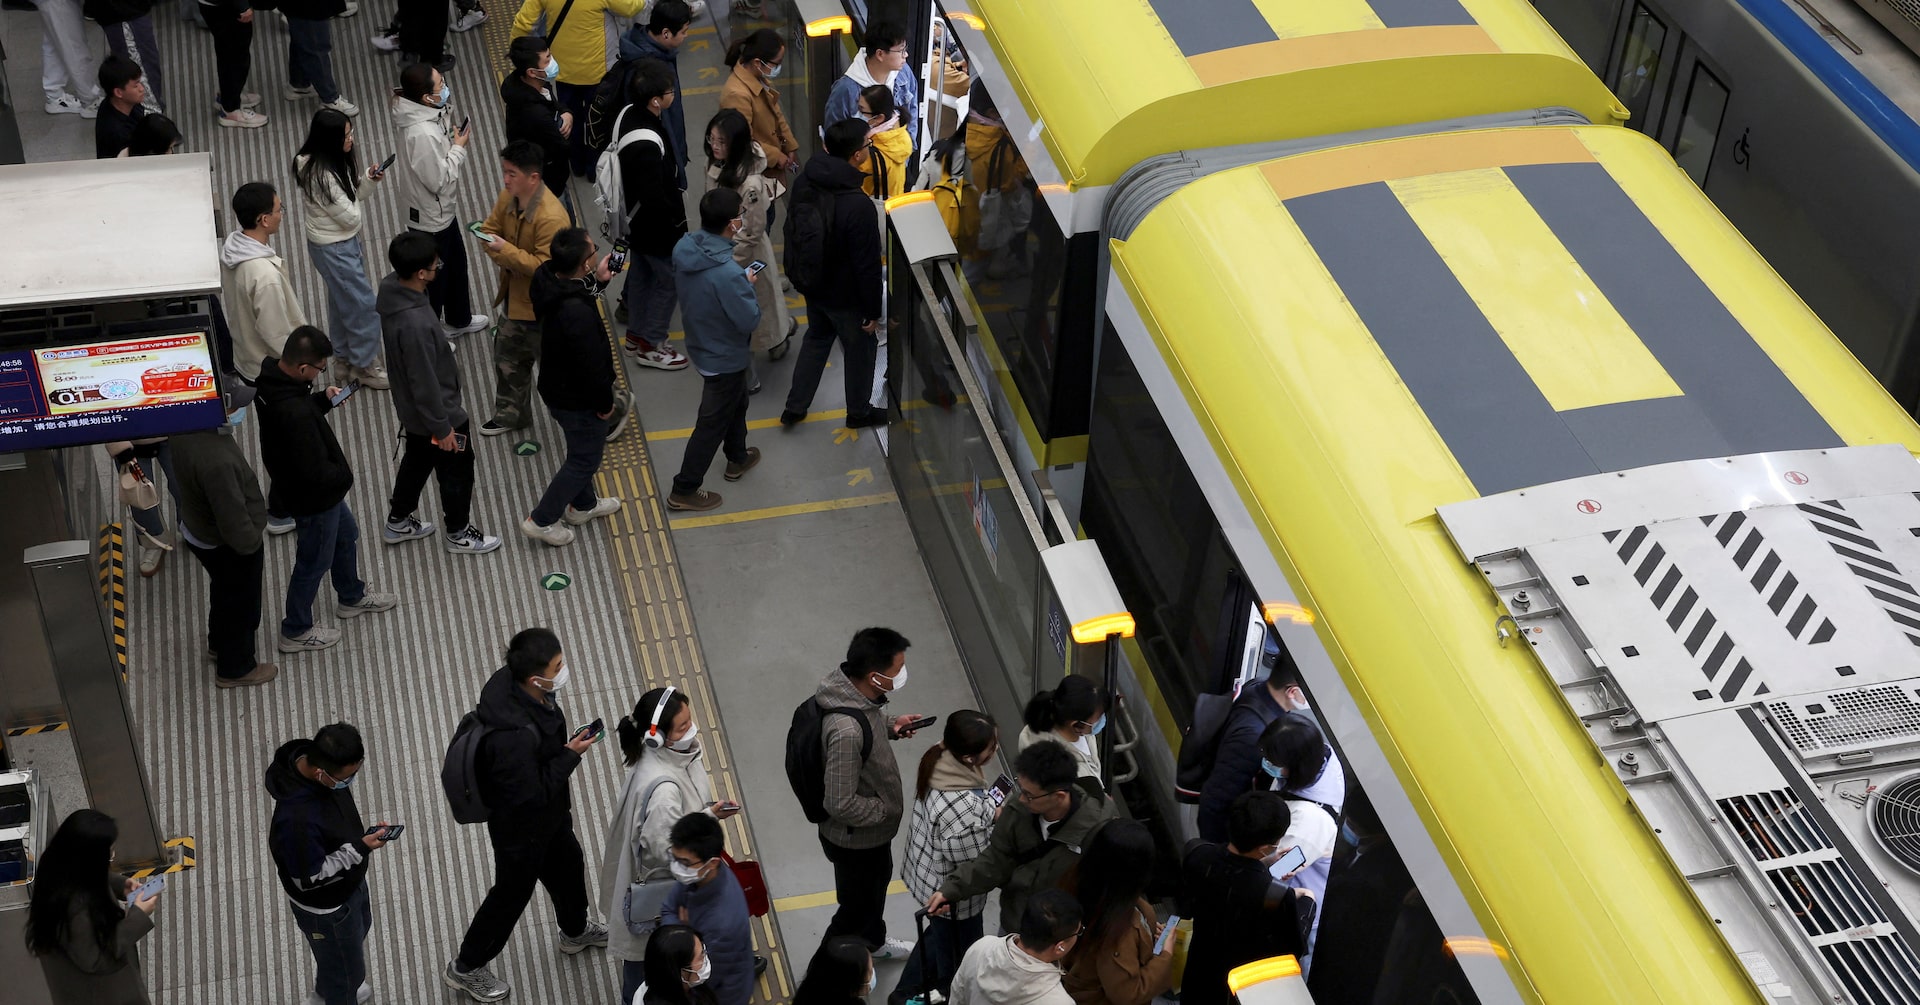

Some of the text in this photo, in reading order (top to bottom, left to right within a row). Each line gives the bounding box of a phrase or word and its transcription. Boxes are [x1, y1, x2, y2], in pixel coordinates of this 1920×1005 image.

[0, 415, 128, 434] 增加，请您合理规划出行。
